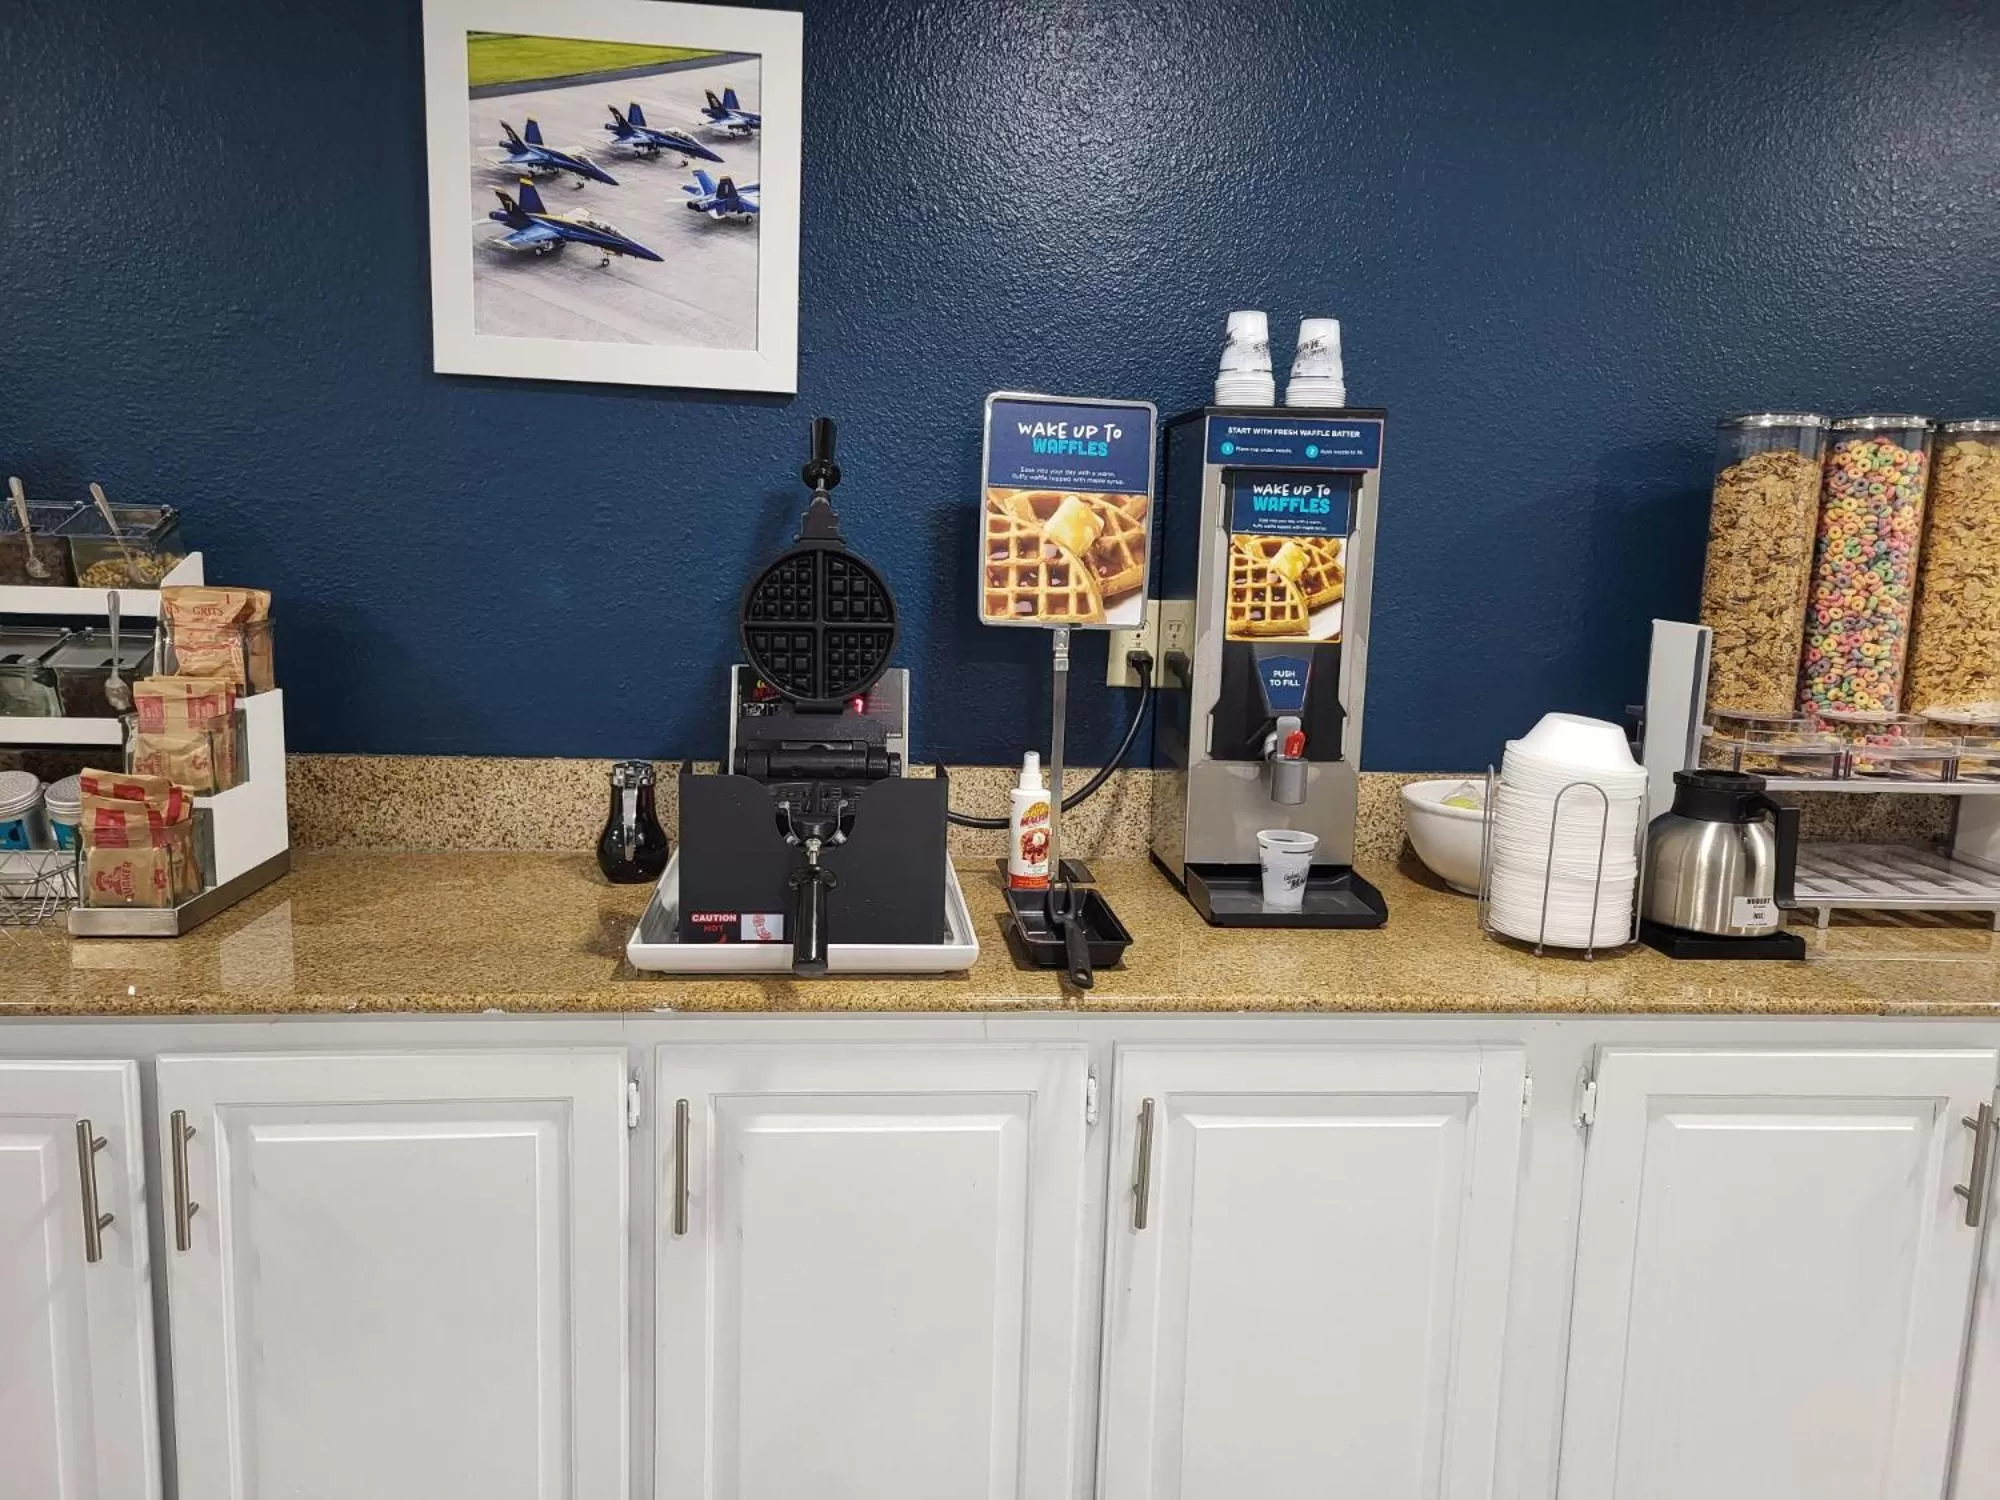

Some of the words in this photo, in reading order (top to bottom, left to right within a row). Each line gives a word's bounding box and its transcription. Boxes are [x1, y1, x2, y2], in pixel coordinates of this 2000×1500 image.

[1017, 421, 1068, 439] WAKE
[1073, 425, 1098, 440] UP
[1227, 426, 1251, 434] START
[1253, 427, 1272, 436] WITH
[1274, 428, 1299, 437] FRESH
[1300, 429, 1330, 438] WAFFLE
[1331, 430, 1361, 438] BATTER
[1032, 438, 1109, 457] WAFFLES
[1253, 484, 1290, 496] WAKE
[1293, 485, 1313, 496] UP
[1252, 496, 1331, 514] WAFFLES
[1272, 670, 1296, 678] PUSH
[1270, 679, 1281, 687] TO
[1283, 679, 1301, 687] FILL
[691, 913, 738, 923] CAUTION
[704, 924, 725, 934] HOT
